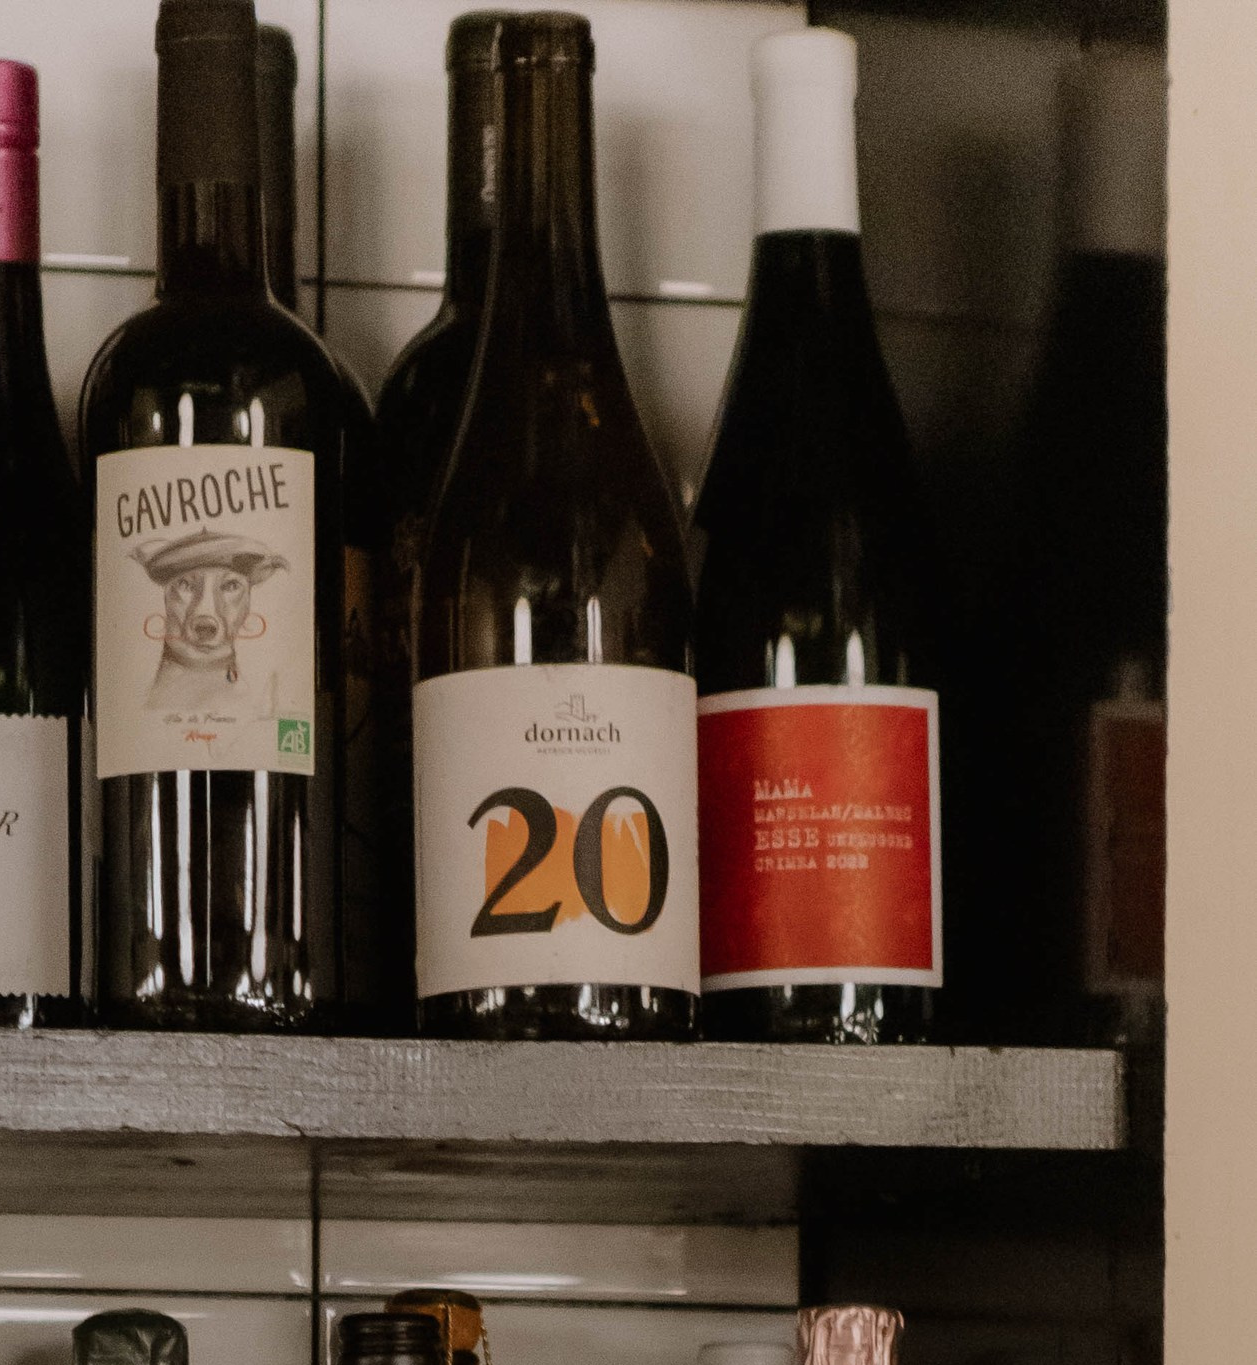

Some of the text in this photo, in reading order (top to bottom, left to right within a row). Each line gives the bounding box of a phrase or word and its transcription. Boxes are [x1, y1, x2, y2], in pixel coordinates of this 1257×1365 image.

[116, 463, 290, 539] GAVROCHE
[524, 722, 622, 744] dornach
[466, 786, 670, 940] 20
[755, 829, 820, 850] ESSE
